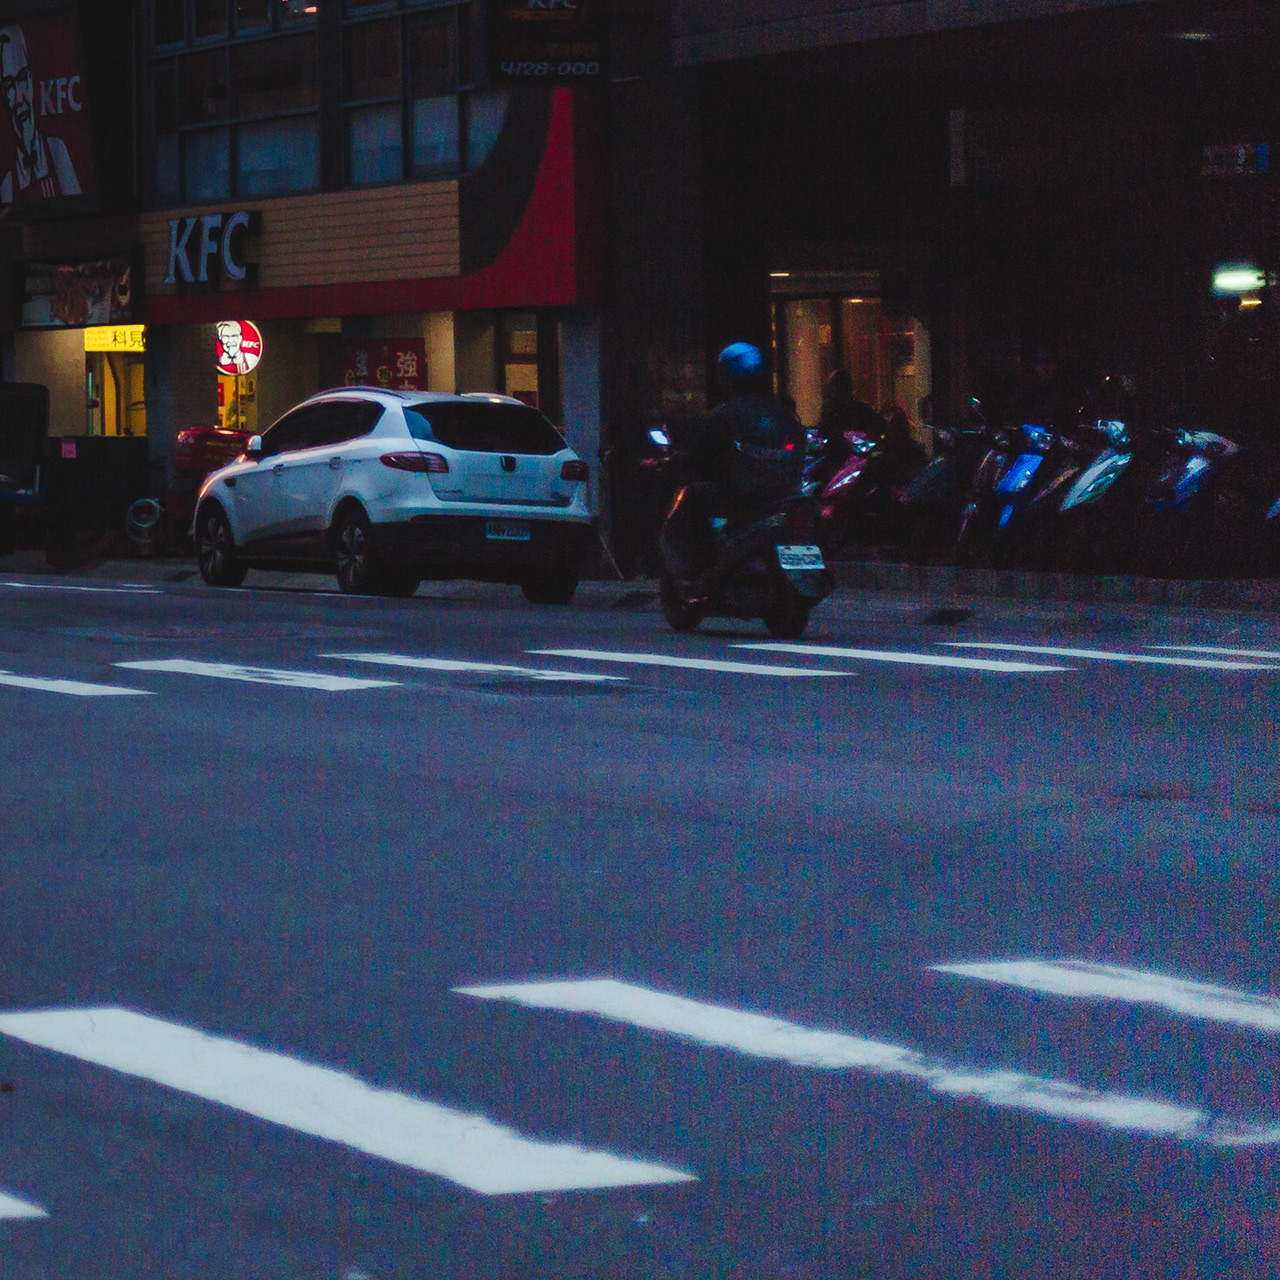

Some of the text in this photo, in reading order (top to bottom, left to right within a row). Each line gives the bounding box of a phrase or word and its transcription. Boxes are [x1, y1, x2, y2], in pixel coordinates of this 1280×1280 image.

[40, 75, 82, 116] KFC
[165, 211, 250, 284] KFC
[241, 338, 261, 350] KFC
